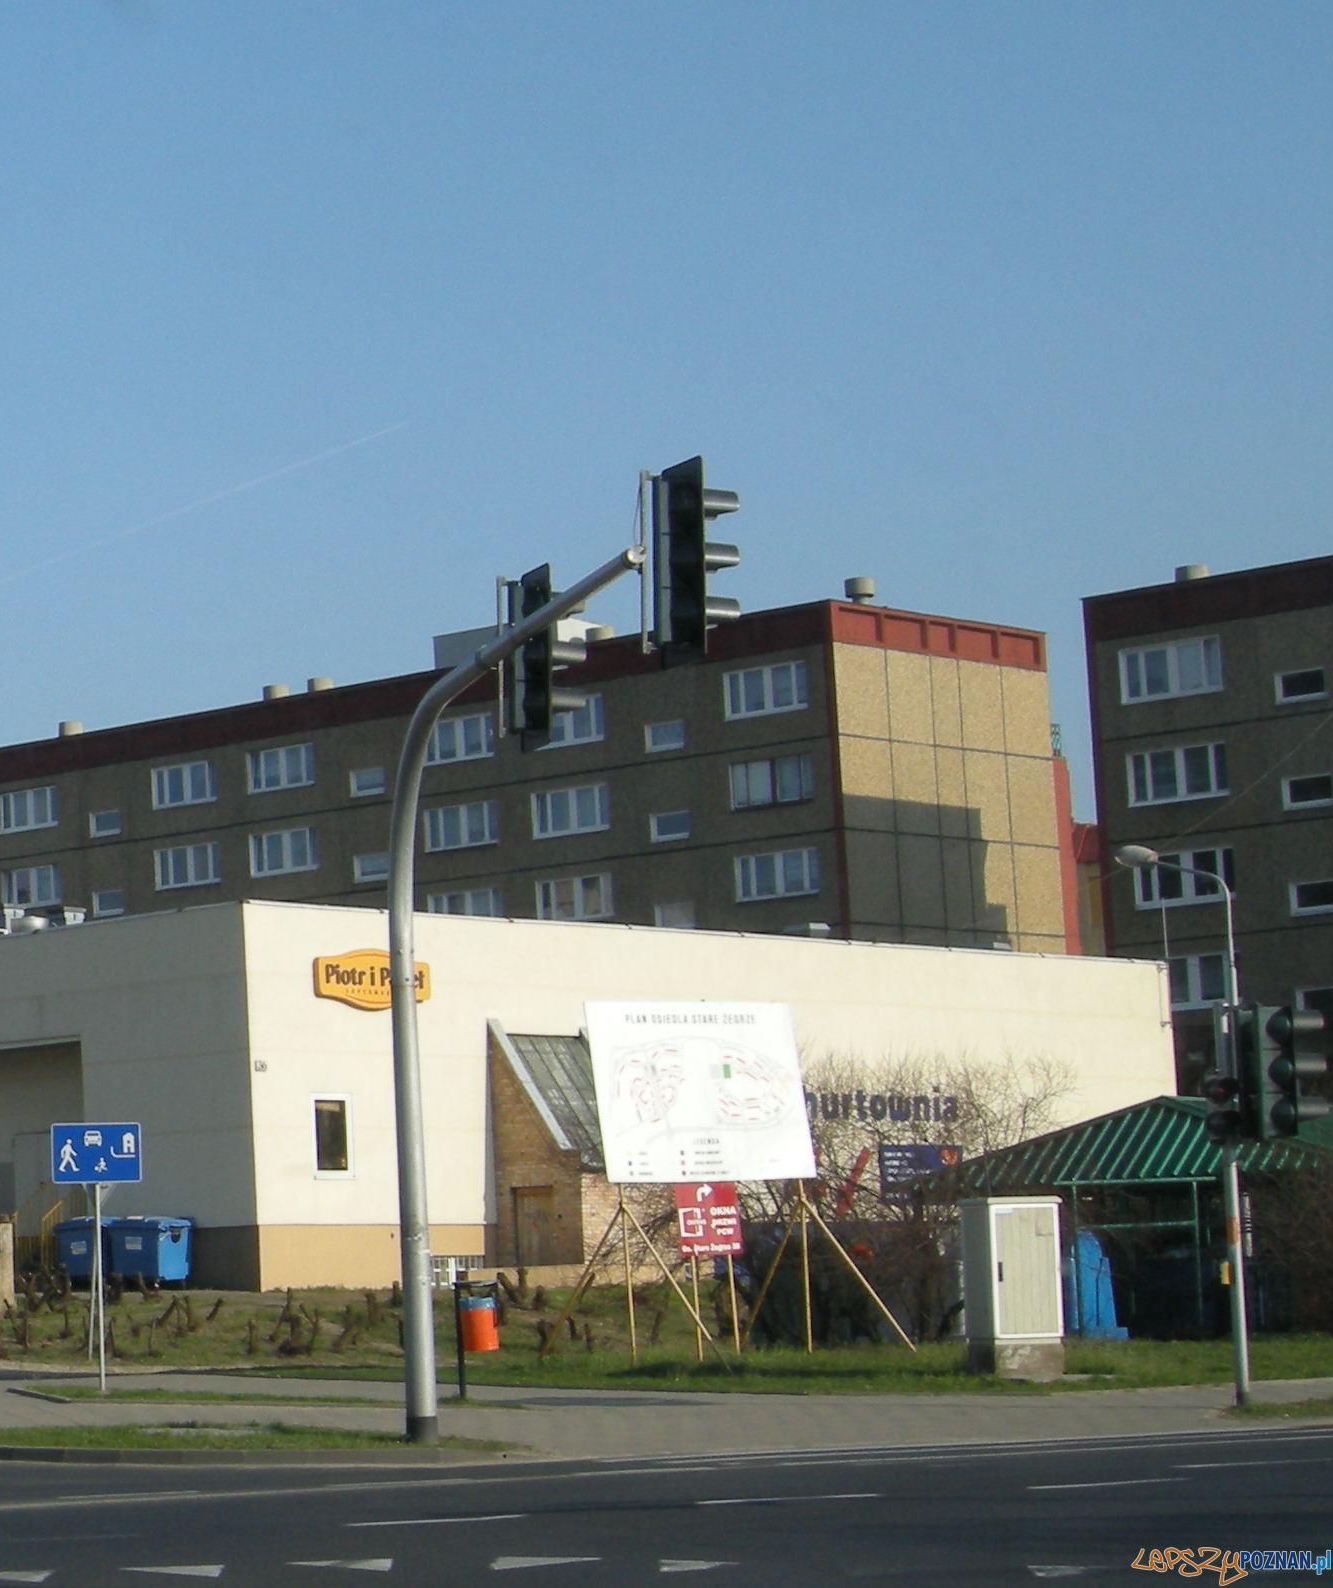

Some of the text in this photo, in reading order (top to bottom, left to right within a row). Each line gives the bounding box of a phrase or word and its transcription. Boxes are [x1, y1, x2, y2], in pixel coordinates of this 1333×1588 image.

[324, 963, 366, 986] Piotr
[370, 966, 376, 986] i
[625, 1014, 648, 1024] PLAN
[651, 1014, 688, 1024] OSIEDLA
[691, 1014, 719, 1024] STARE
[709, 1205, 737, 1216] OKNA
